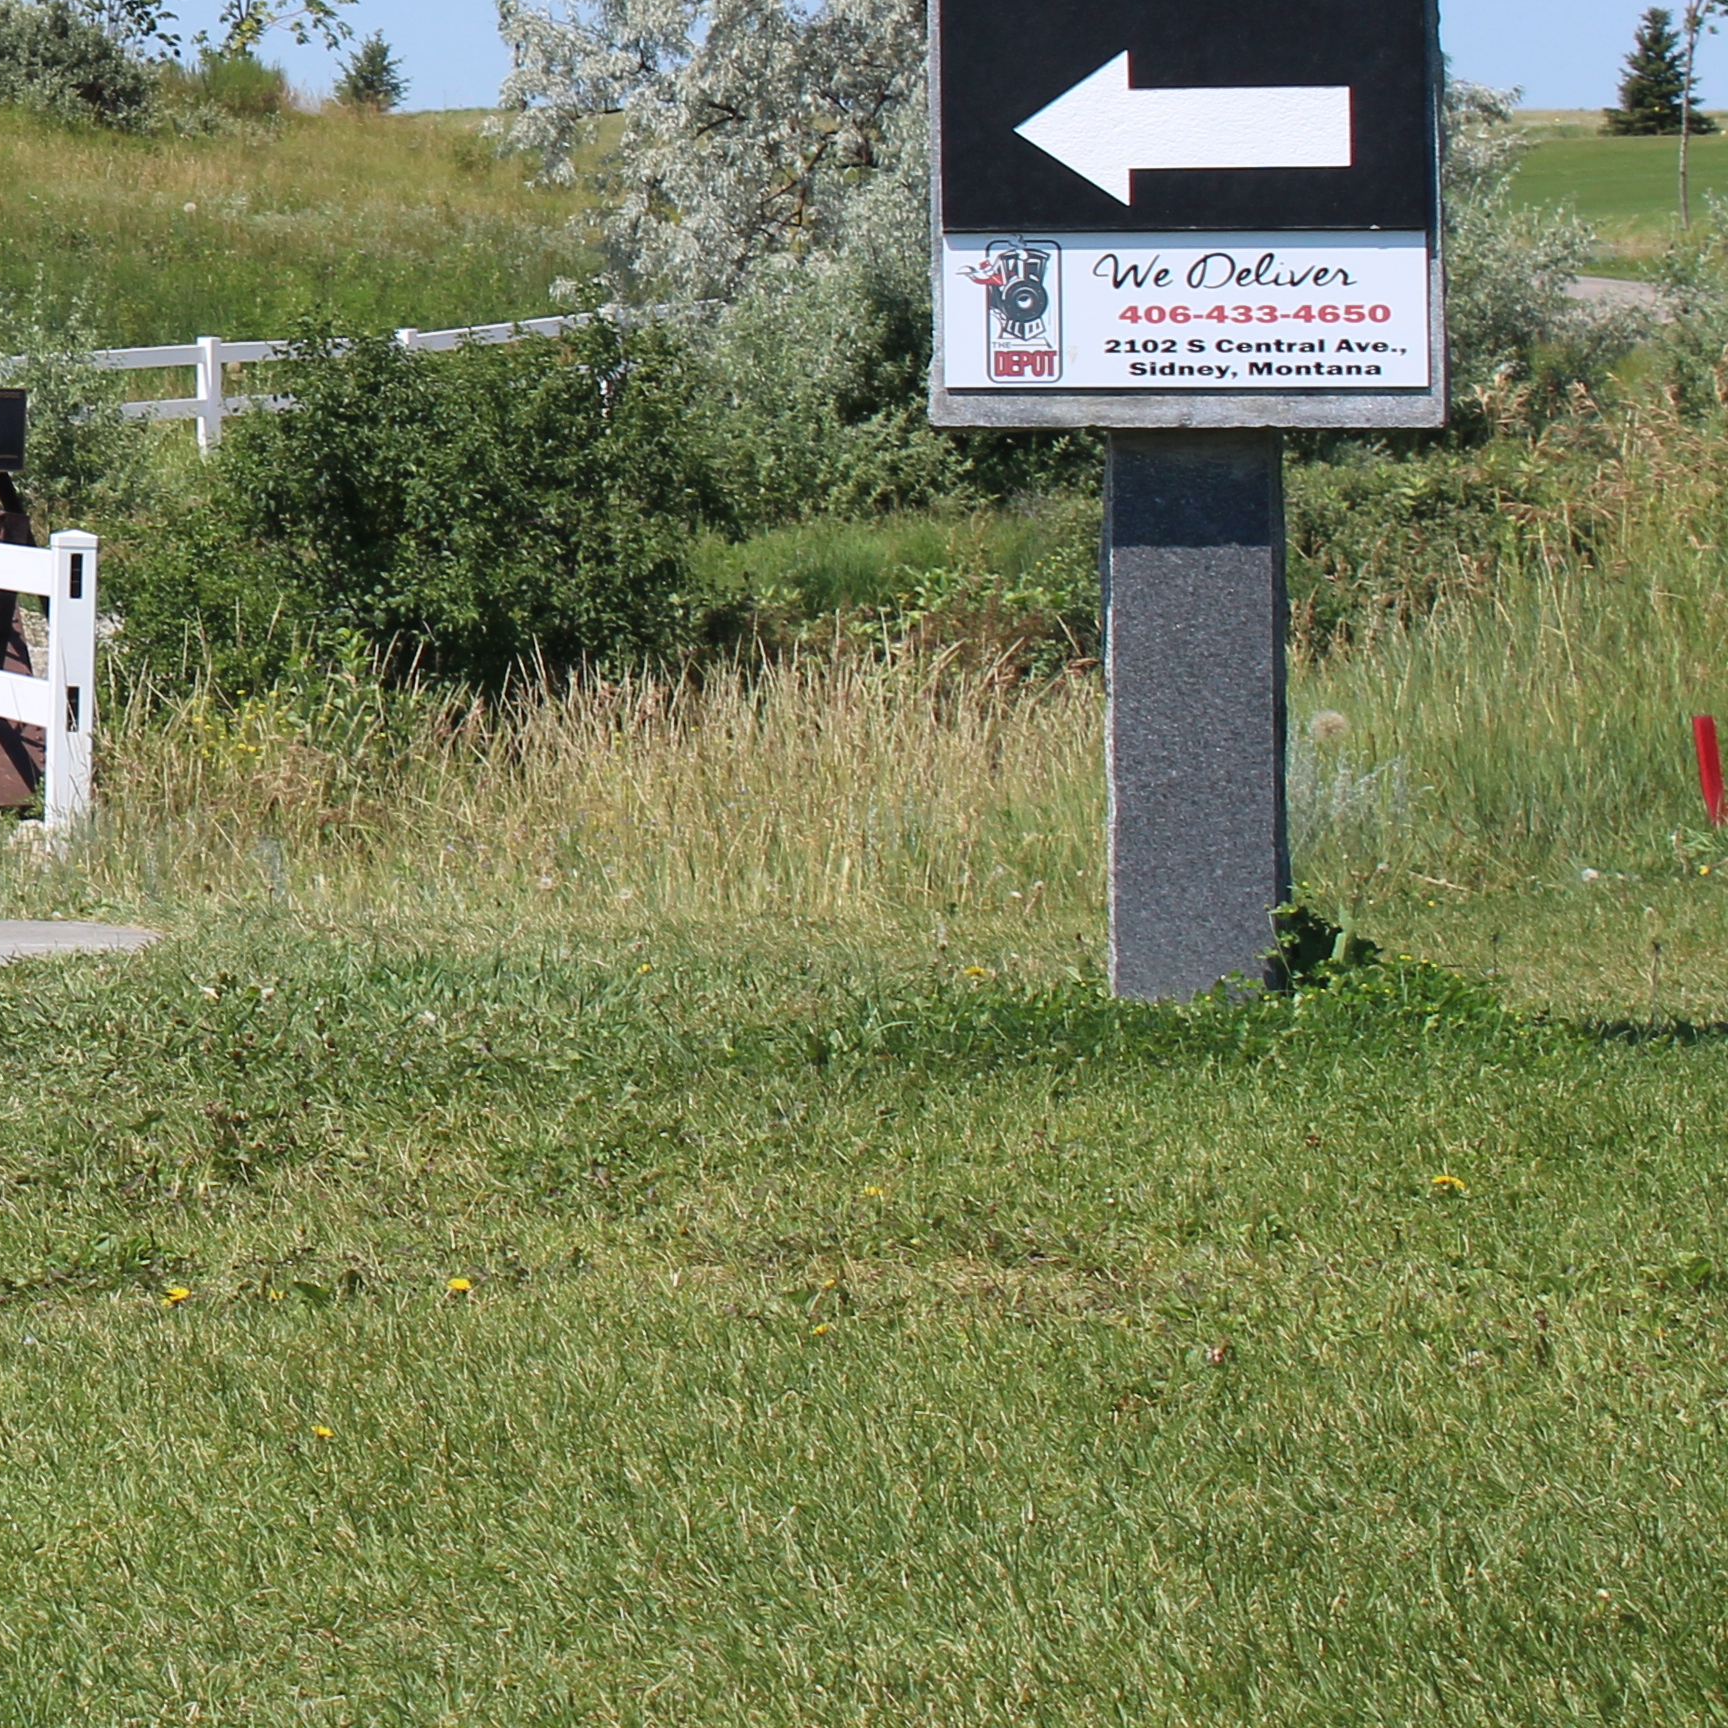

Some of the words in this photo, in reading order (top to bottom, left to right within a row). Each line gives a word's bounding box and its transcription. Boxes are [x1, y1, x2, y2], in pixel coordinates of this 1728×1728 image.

[1092, 252, 1174, 290] We
[1186, 252, 1357, 290] Deliver
[1118, 304, 1392, 325] 406-433-4650
[992, 341, 1012, 350] THE
[1103, 338, 1178, 354] 2102
[1187, 338, 1206, 354] S
[1215, 338, 1324, 354] Central
[1334, 338, 1408, 357] Ave.,
[994, 350, 1058, 378] DEPOT
[1129, 360, 1238, 380] Sidney,
[1247, 360, 1382, 378] Montana
